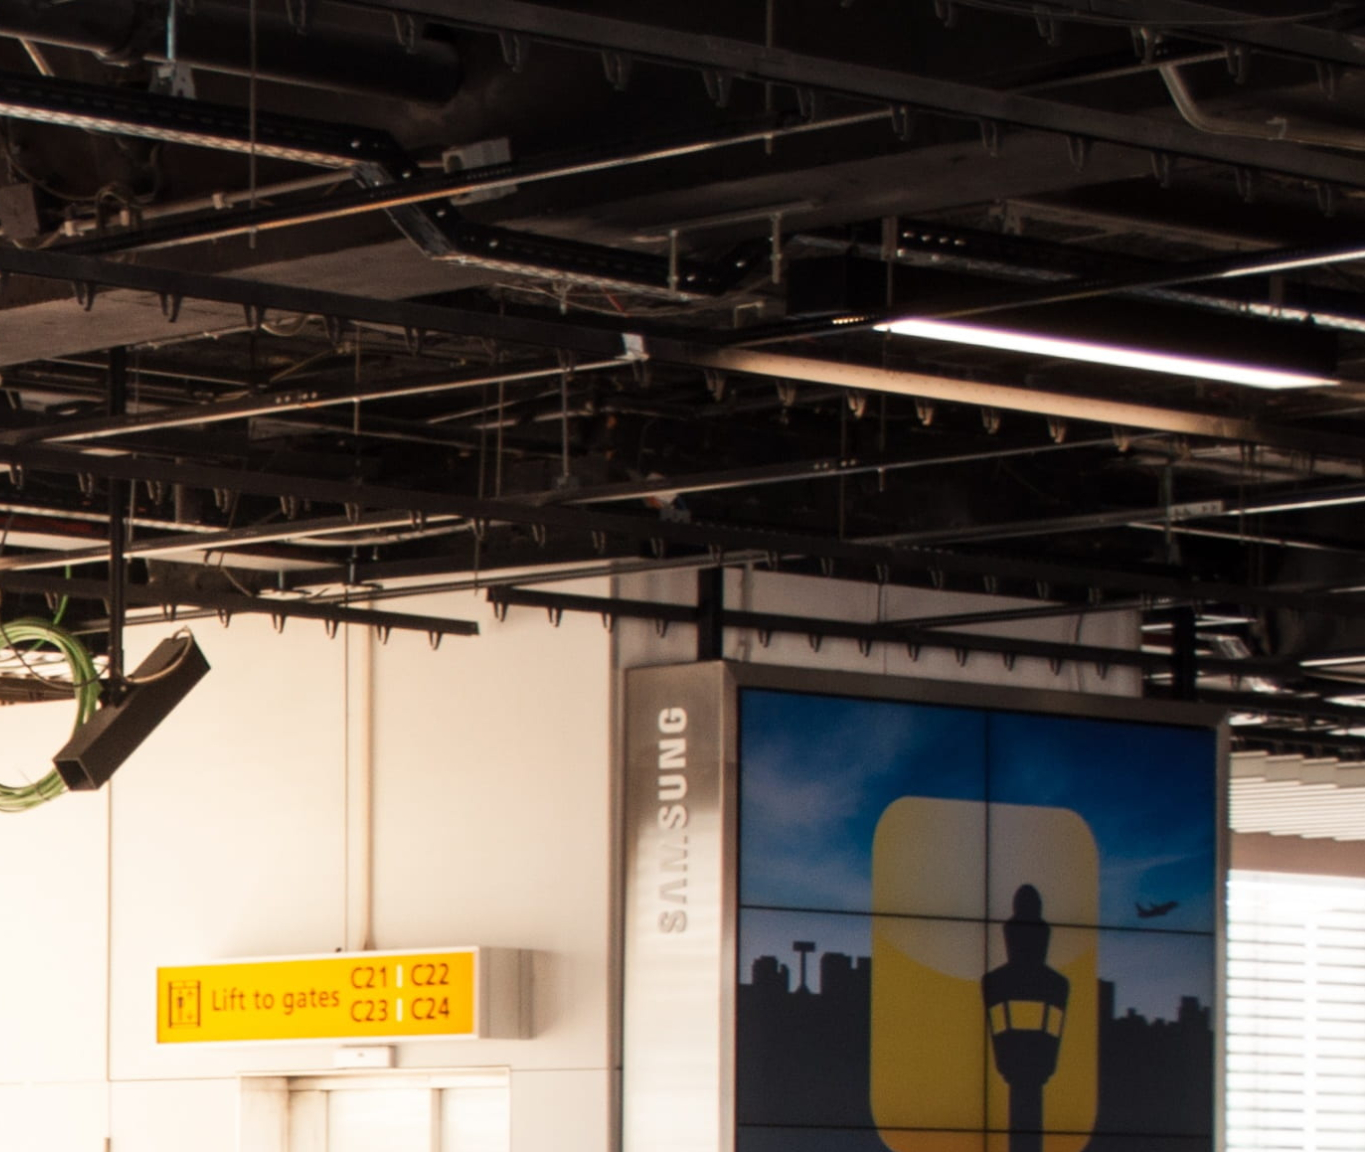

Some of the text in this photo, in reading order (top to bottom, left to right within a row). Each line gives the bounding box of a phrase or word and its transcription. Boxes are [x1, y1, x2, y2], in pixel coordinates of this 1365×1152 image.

[658, 707, 688, 933] SAMSUNG
[351, 963, 449, 989] C21 C22
[212, 988, 340, 1015] Lift to gates
[351, 997, 450, 1022] C23 C24
